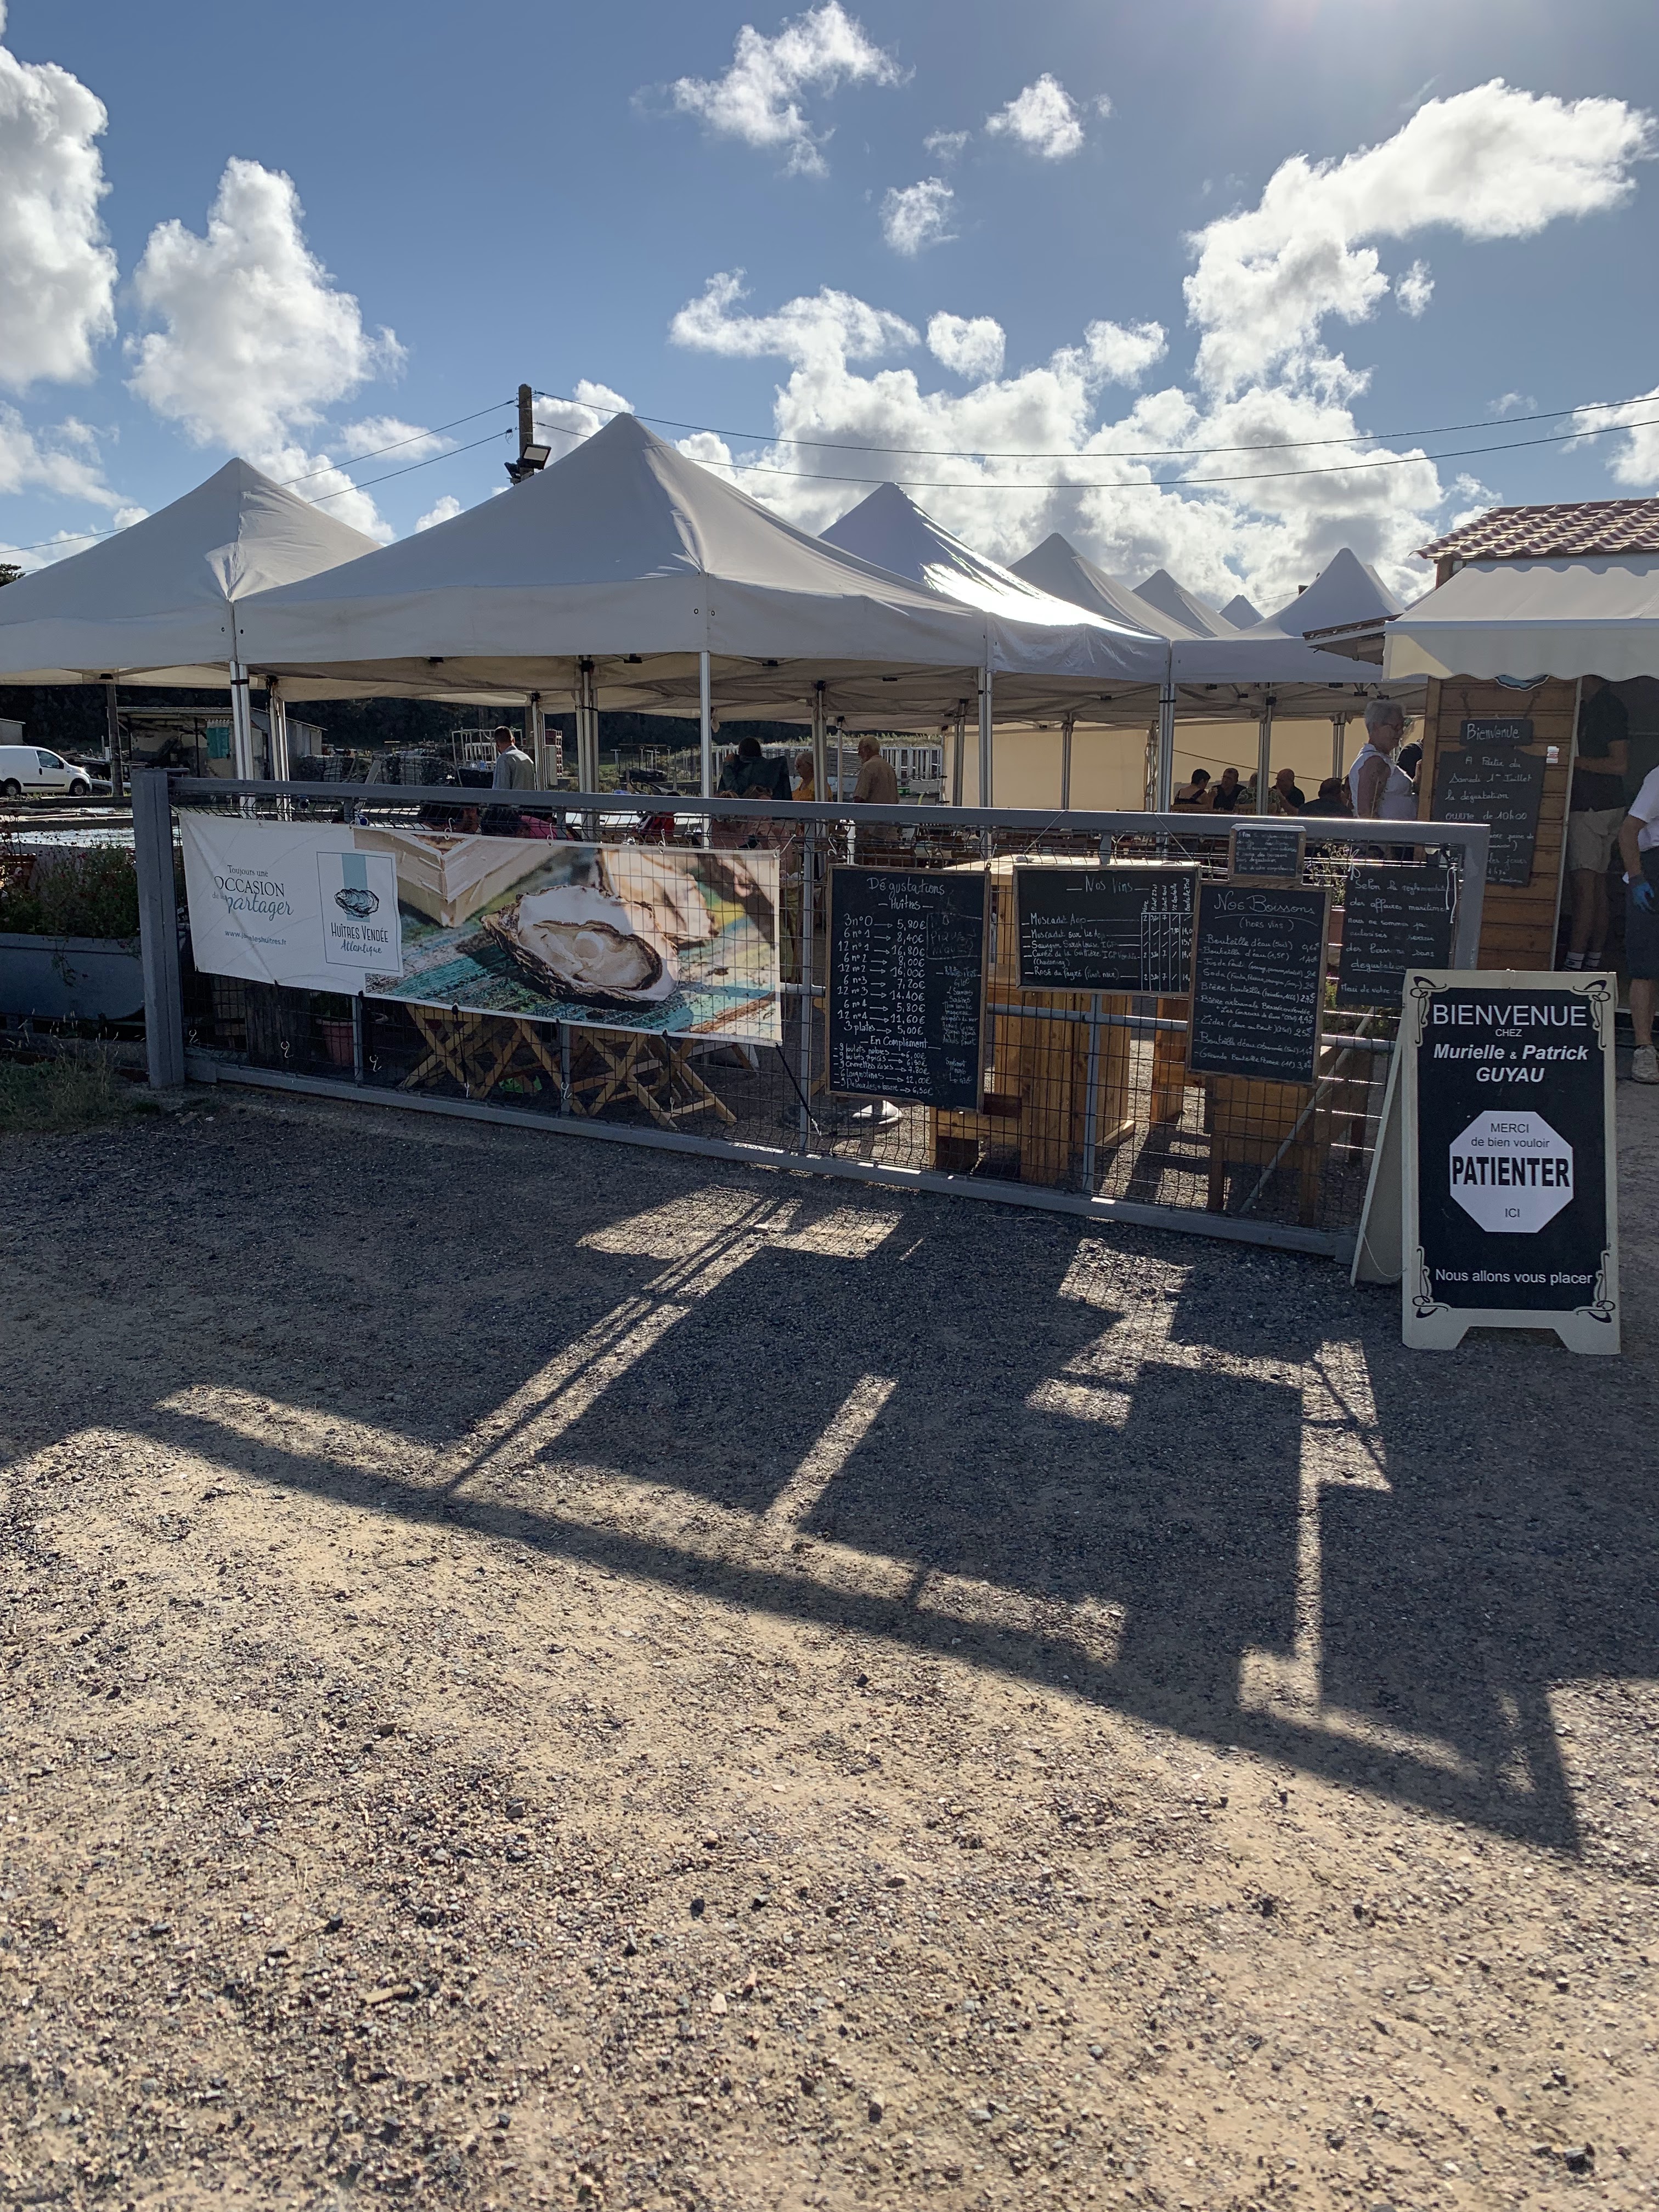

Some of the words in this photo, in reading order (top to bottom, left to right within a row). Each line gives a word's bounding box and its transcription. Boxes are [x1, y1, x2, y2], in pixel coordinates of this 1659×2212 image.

[1467, 723, 1520, 740] Bienvenue
[1465, 756, 1473, 764] A
[1483, 810, 1493, 820] de
[227, 865, 255, 876] Toujours
[214, 876, 284, 897] OCCASION
[1085, 875, 1106, 893] Nos
[1355, 878, 1381, 890] Selon
[225, 893, 294, 921] partager
[891, 894, 921, 910] Huîtres
[1214, 890, 1245, 911] Nos
[1246, 894, 1316, 915] Boissons
[331, 922, 360, 940] HUÎTRES
[361, 925, 388, 943] VENDÉE
[1204, 934, 1249, 946] Bouteille
[340, 939, 382, 957] Atlantique
[1034, 966, 1052, 976] Rosé
[1203, 968, 1226, 978] Soda
[1433, 1004, 1588, 1027] BIENVENUE
[1495, 1029, 1522, 1037] CHEZ
[871, 1035, 881, 1045] En
[883, 1037, 928, 1051] Complément
[1434, 1043, 1505, 1060] Murielle
[1510, 1051, 1517, 1059] &
[1522, 1044, 1589, 1062] Patrick
[1476, 1067, 1545, 1083] GUYAU
[1491, 1122, 1530, 1133] MERCI
[1471, 1136, 1485, 1147] de
[1488, 1137, 1510, 1147] bien
[1514, 1137, 1550, 1148] vouloir
[1452, 1155, 1571, 1187] PATIENTER
[1504, 1207, 1521, 1218] ICI
[1435, 1268, 1469, 1282] Nous
[1472, 1270, 1511, 1283] allons
[1514, 1273, 1547, 1284] vous
[1550, 1271, 1593, 1286] placer
